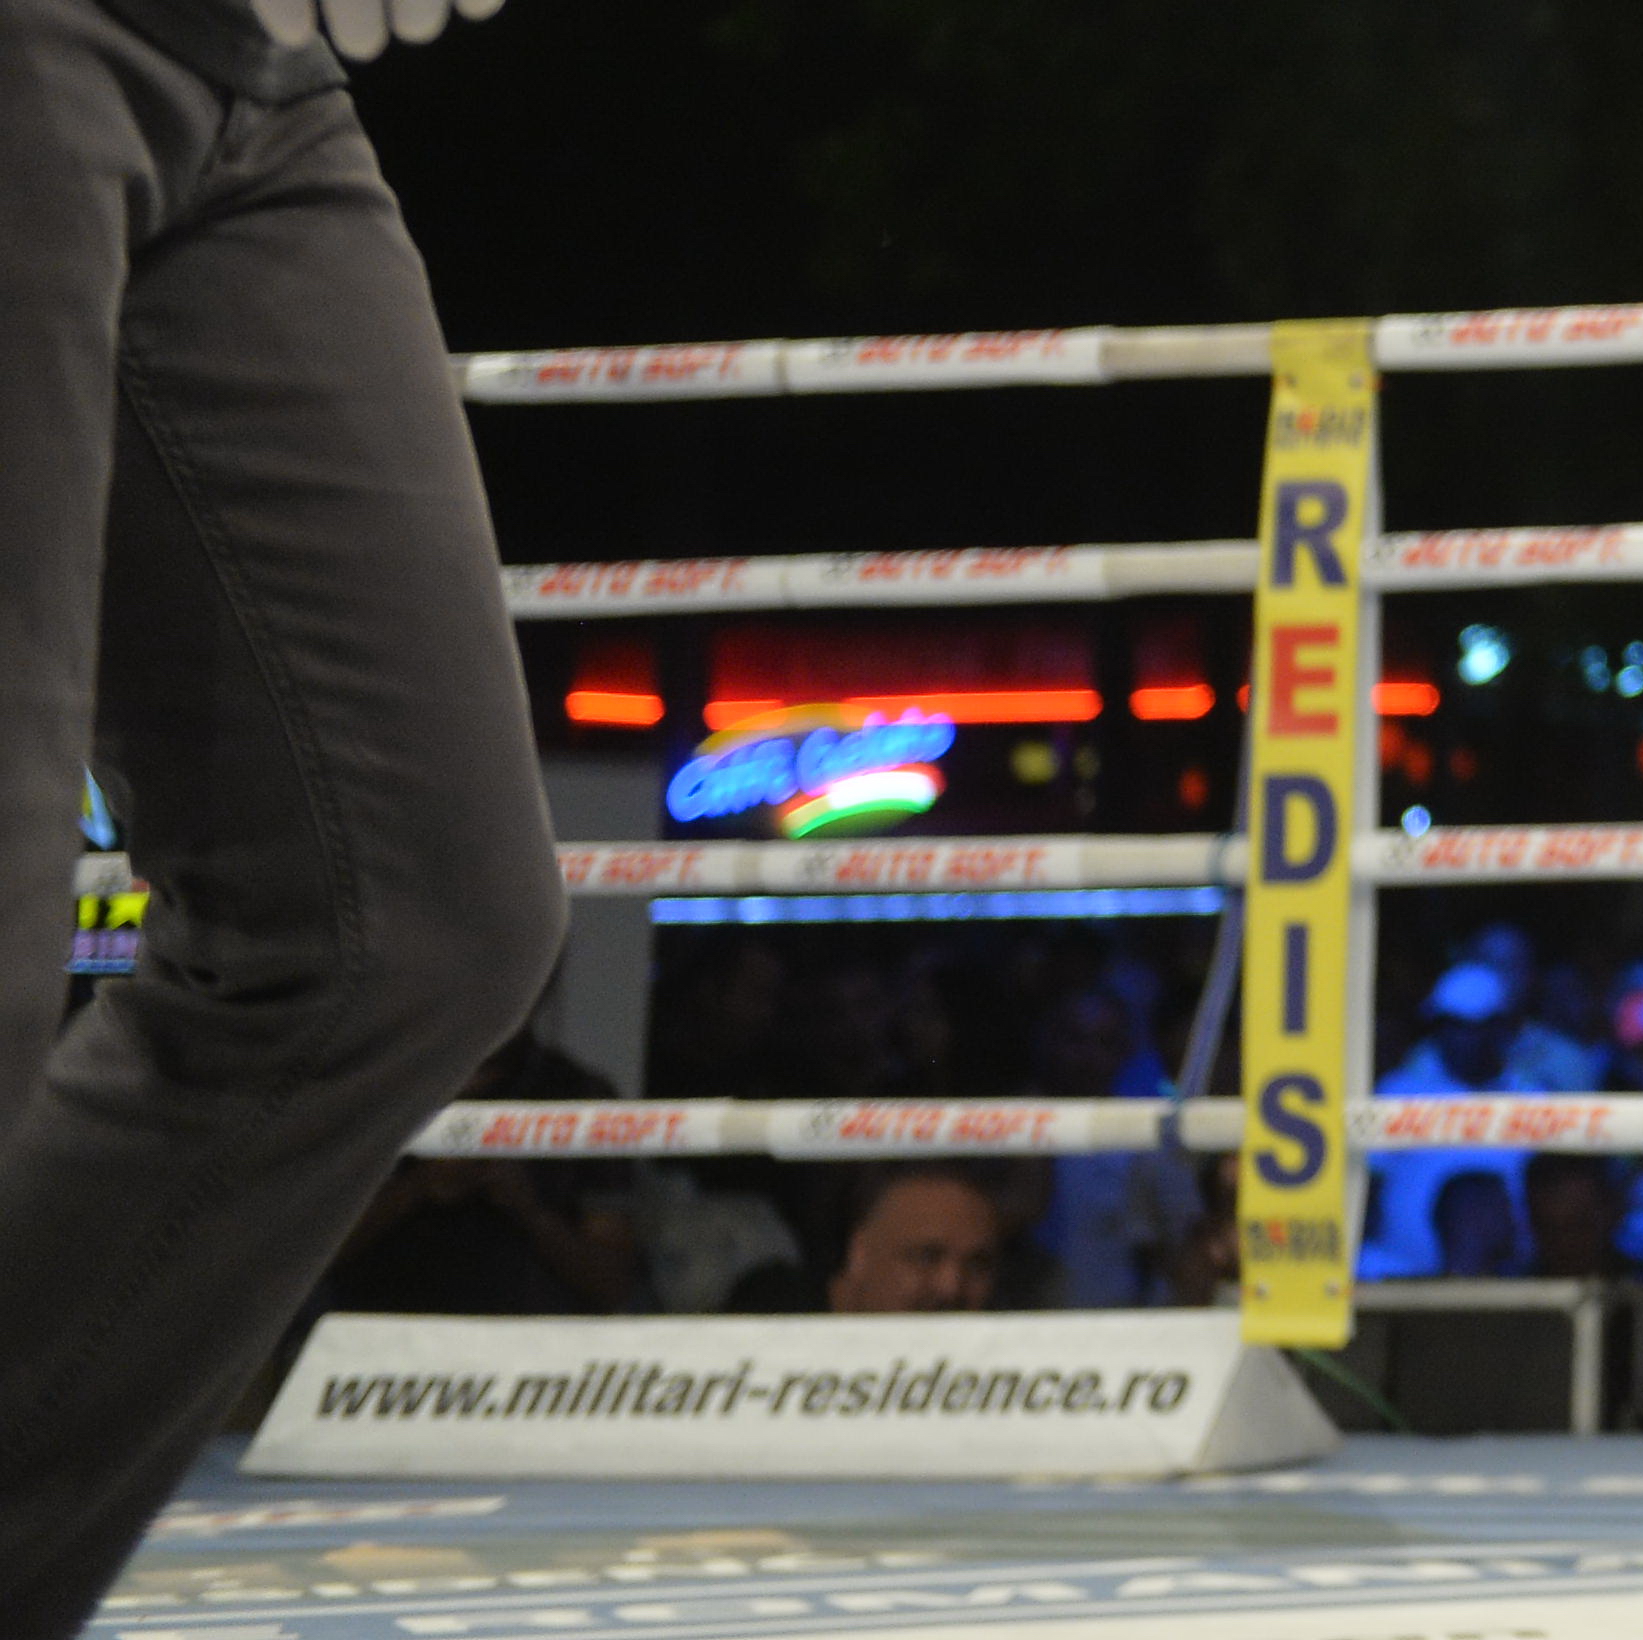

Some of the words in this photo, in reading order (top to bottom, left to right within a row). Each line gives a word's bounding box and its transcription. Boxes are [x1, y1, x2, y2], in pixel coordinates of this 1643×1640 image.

[1448, 308, 1553, 346] AUTO
[536, 349, 632, 384] AUTO
[855, 336, 957, 365] AUTO
[857, 551, 958, 581] AUTO
[1400, 531, 1507, 568] AUTO
[537, 564, 633, 597] AUTO
[1253, 479, 1350, 1189] REDIS
[1420, 828, 1532, 869] AUTO
[834, 847, 938, 883] AUTO
[480, 1112, 582, 1147] AUTO
[838, 1103, 931, 1141] AUTO
[1383, 1103, 1496, 1141] AUTO
[315, 1358, 1192, 1420] www.militari-residence.ro
